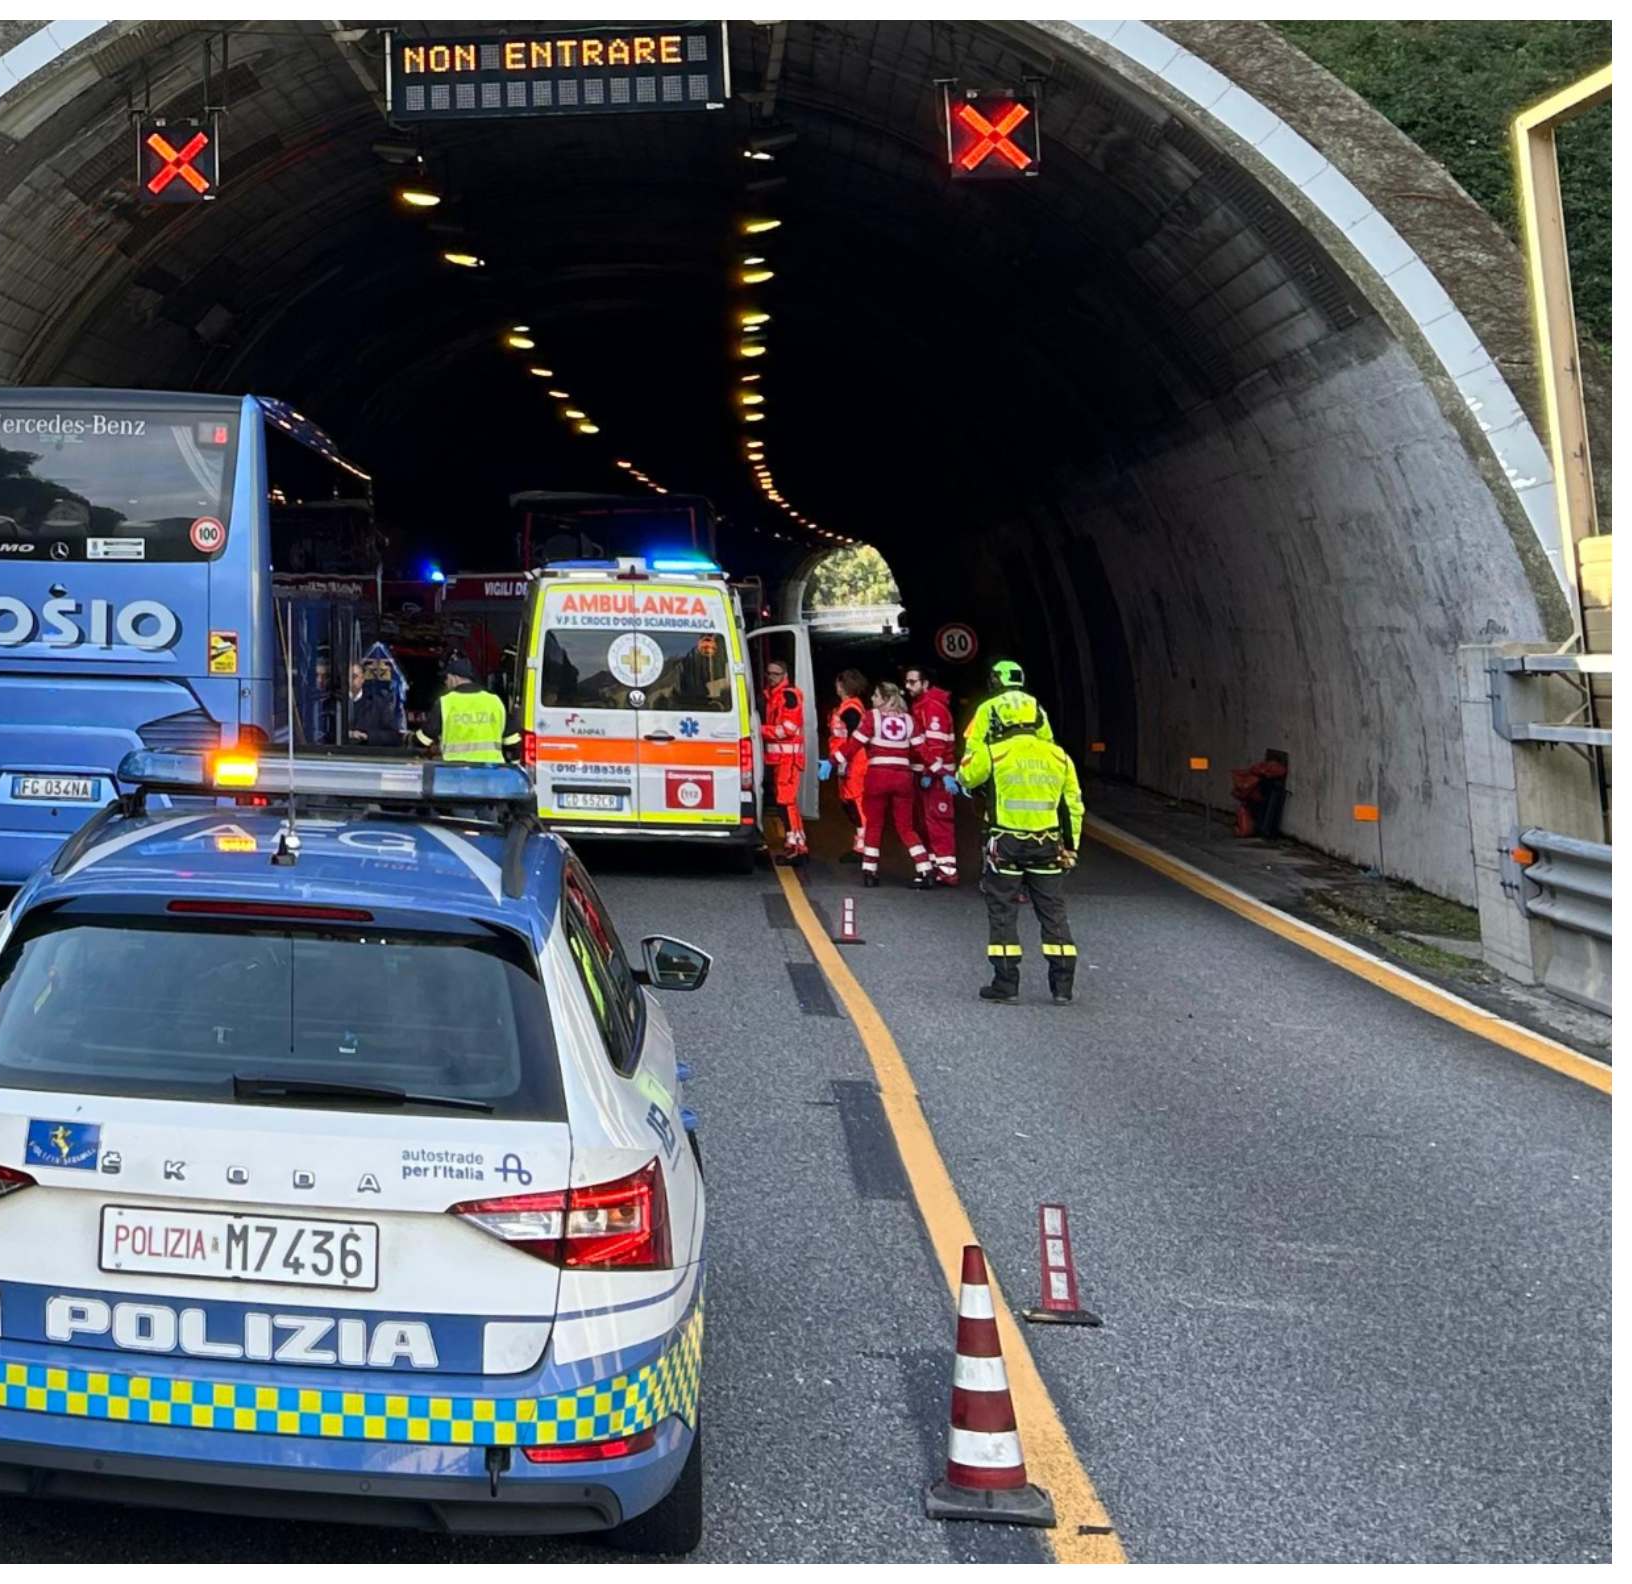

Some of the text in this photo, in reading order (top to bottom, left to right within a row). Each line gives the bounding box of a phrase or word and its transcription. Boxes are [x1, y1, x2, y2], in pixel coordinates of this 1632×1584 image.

[404, 36, 682, 74] NON ENTRARE
[198, 527, 218, 542] 100
[484, 581, 513, 596] VIGILI
[561, 593, 707, 616] AMBULANZA
[580, 616, 612, 626] CROCE
[644, 617, 716, 629] SCIARBORASCA
[945, 634, 968, 652] 80
[453, 711, 497, 725] POLIZIA
[21, 779, 89, 796] FG 034NA
[401, 1148, 484, 1165] autostrade
[402, 1164, 484, 1181] per l'Italia
[113, 1222, 363, 1280] POLIZIA M7436
[45, 1294, 440, 1369] POLIZIA
